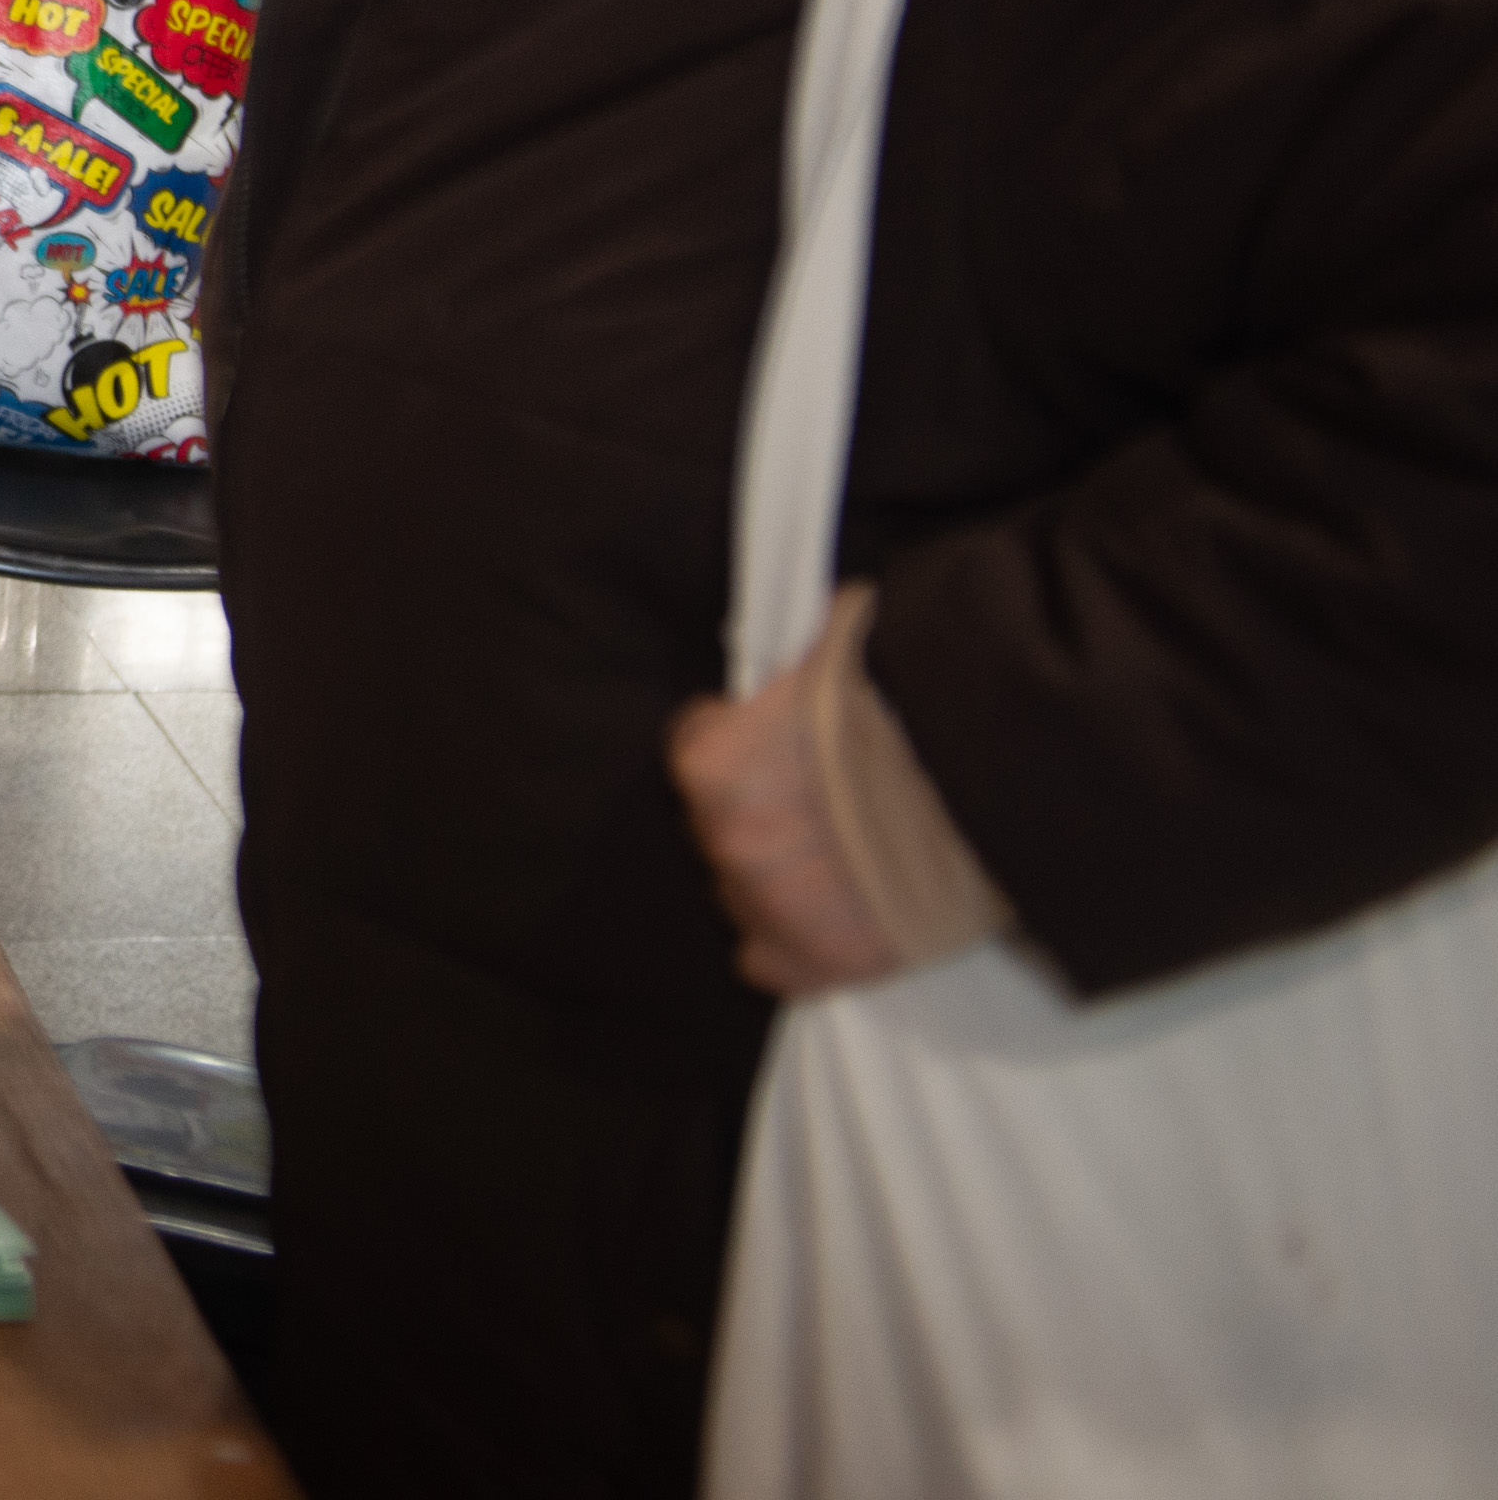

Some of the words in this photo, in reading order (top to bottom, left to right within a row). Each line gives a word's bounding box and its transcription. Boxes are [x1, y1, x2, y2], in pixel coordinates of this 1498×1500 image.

[96, 47, 180, 125] SPECIAL
[45, 243, 87, 263] HOT
[105, 265, 185, 304] SALE
[46, 338, 189, 441] HOT
